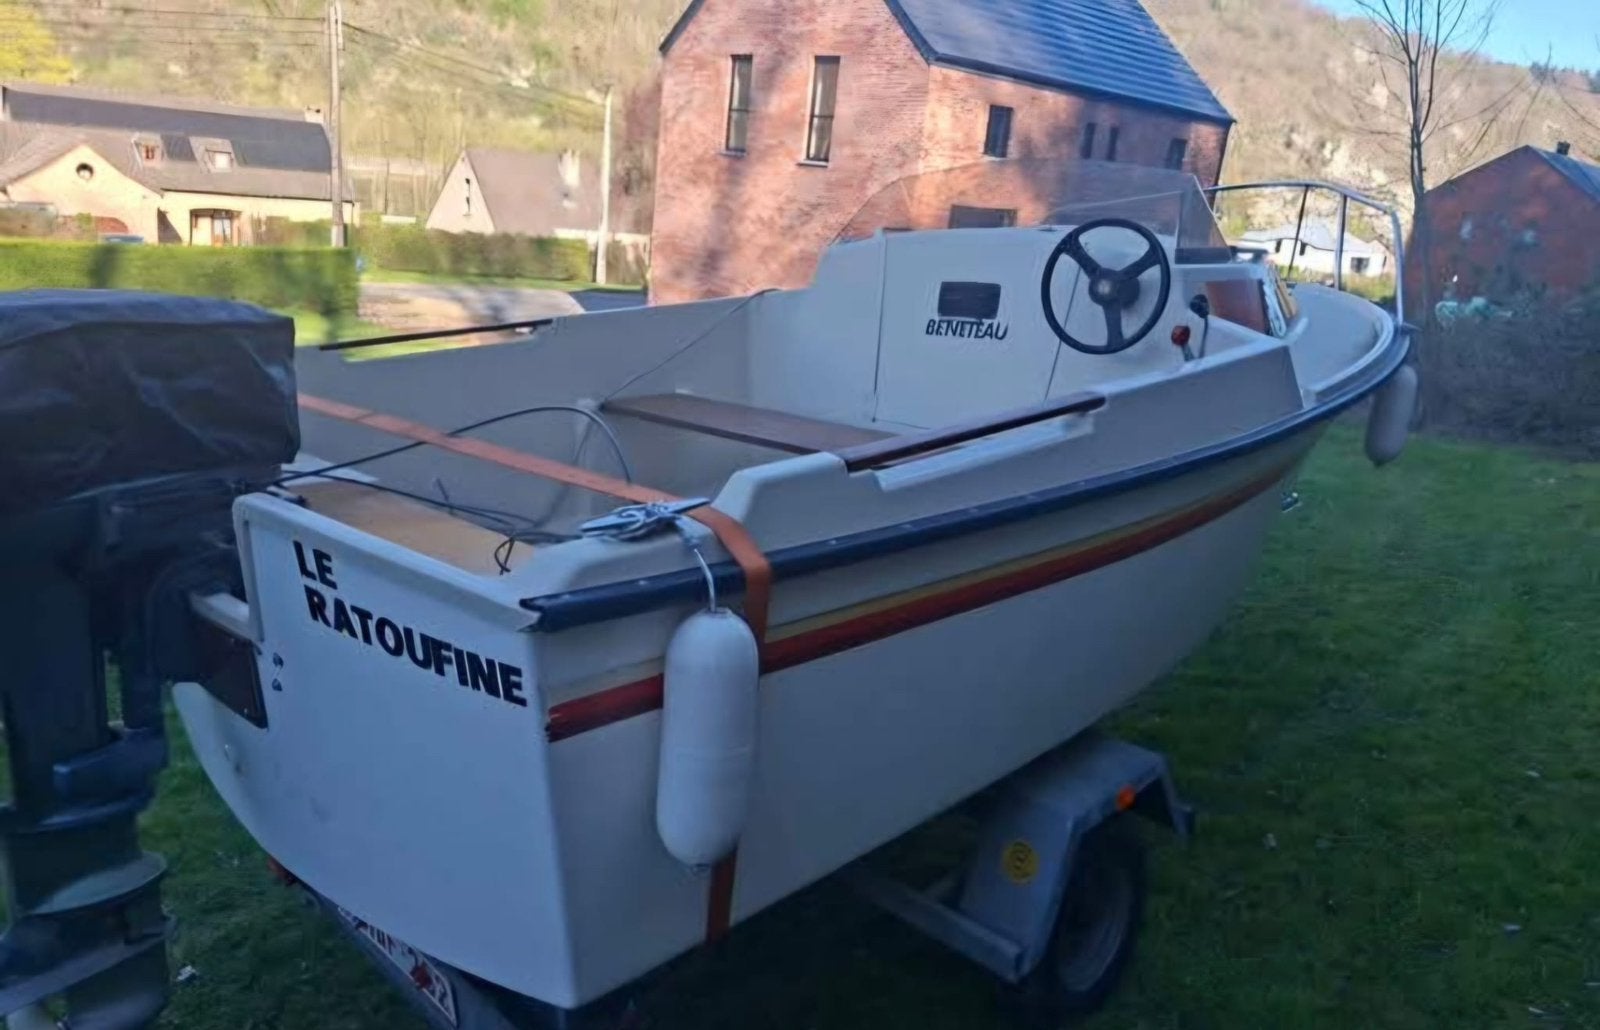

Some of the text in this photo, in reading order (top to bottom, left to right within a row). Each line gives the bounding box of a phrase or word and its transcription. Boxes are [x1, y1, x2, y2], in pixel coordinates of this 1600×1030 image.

[925, 319, 1009, 340] BENETEAU
[293, 540, 338, 590] LE
[304, 585, 528, 707] RATOUFINE
